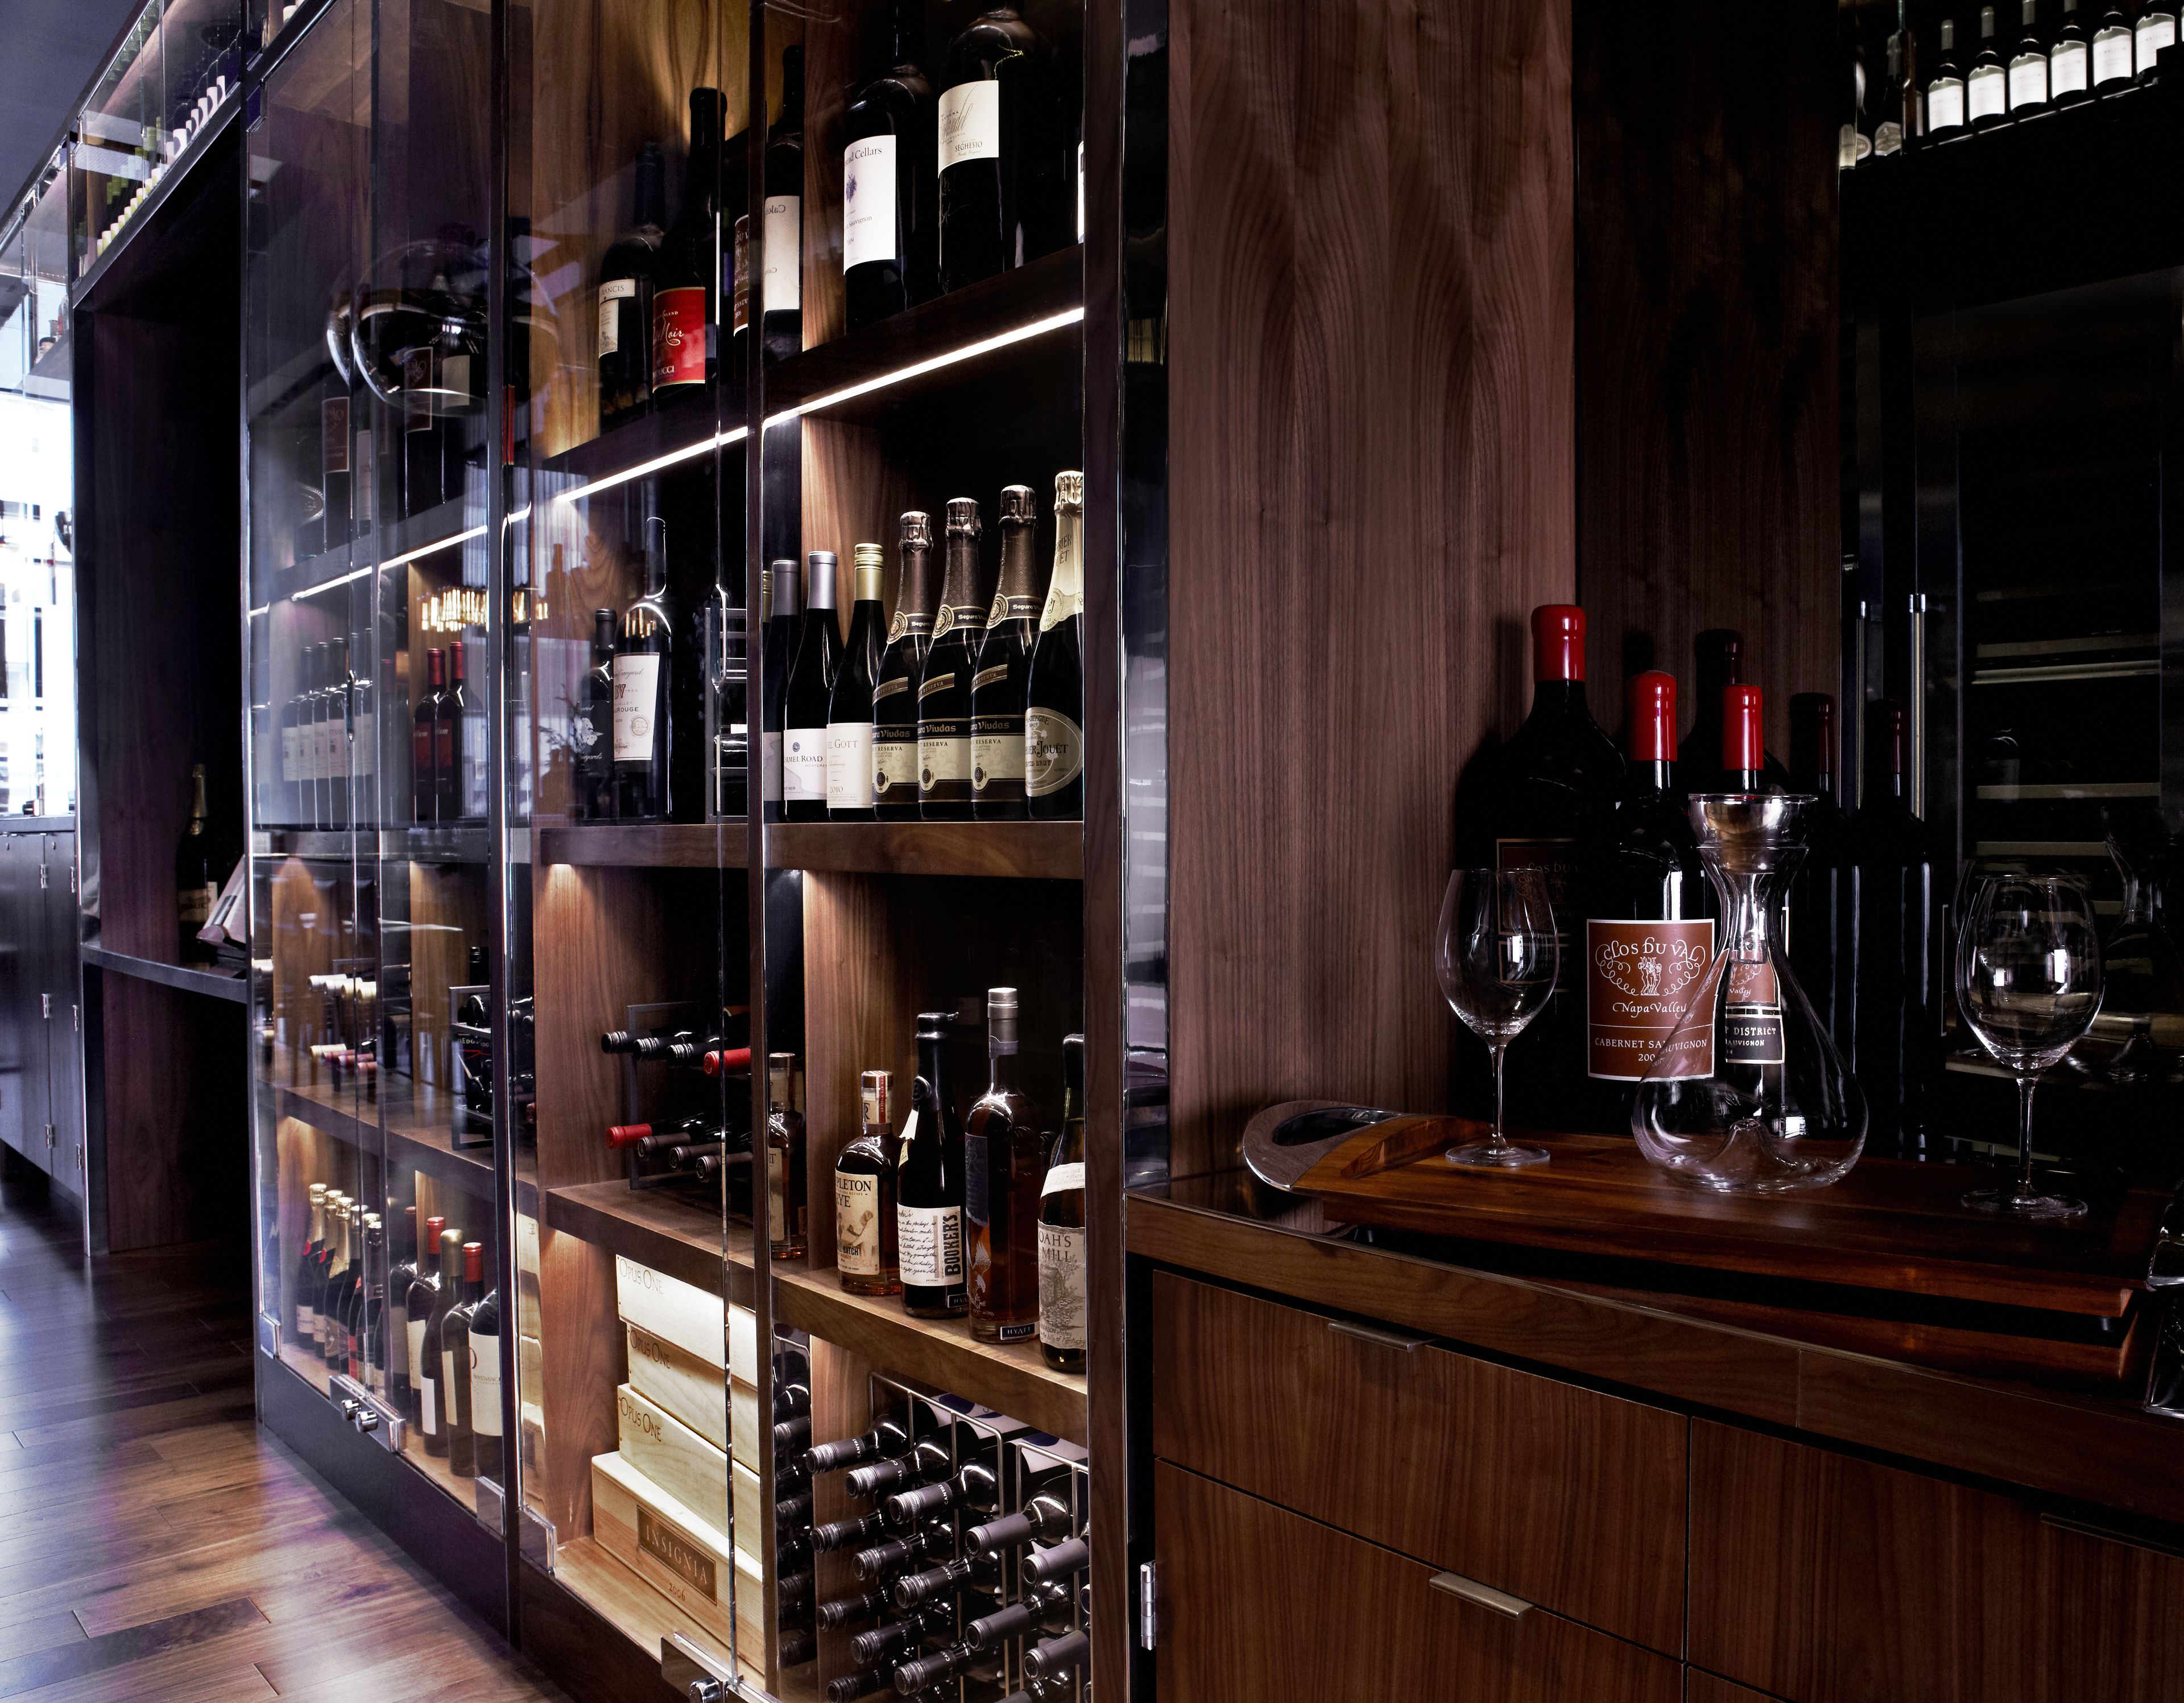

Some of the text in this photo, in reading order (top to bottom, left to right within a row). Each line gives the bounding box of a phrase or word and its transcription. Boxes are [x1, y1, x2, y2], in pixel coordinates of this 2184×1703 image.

[855, 147, 882, 159] Cellars
[956, 141, 982, 152] SEGHESIO
[926, 724, 956, 733] Viudas
[978, 721, 1010, 730] Viudas
[1670, 939, 1702, 962] VAL
[1612, 1001, 1687, 1019] Napa Valley
[1734, 1027, 1776, 1036] DISTRICT
[1595, 1037, 1644, 1048] CABERNET
[942, 1214, 961, 1276] BOOKER'S
[1039, 1231, 1072, 1247] OAH'S
[843, 1246, 858, 1256] BATCH
[1042, 1247, 1072, 1262] MILL
[938, 1484, 949, 1504] CANVAS
[647, 1526, 707, 1584] INSIGNIA
[669, 1583, 685, 1601] 2006
